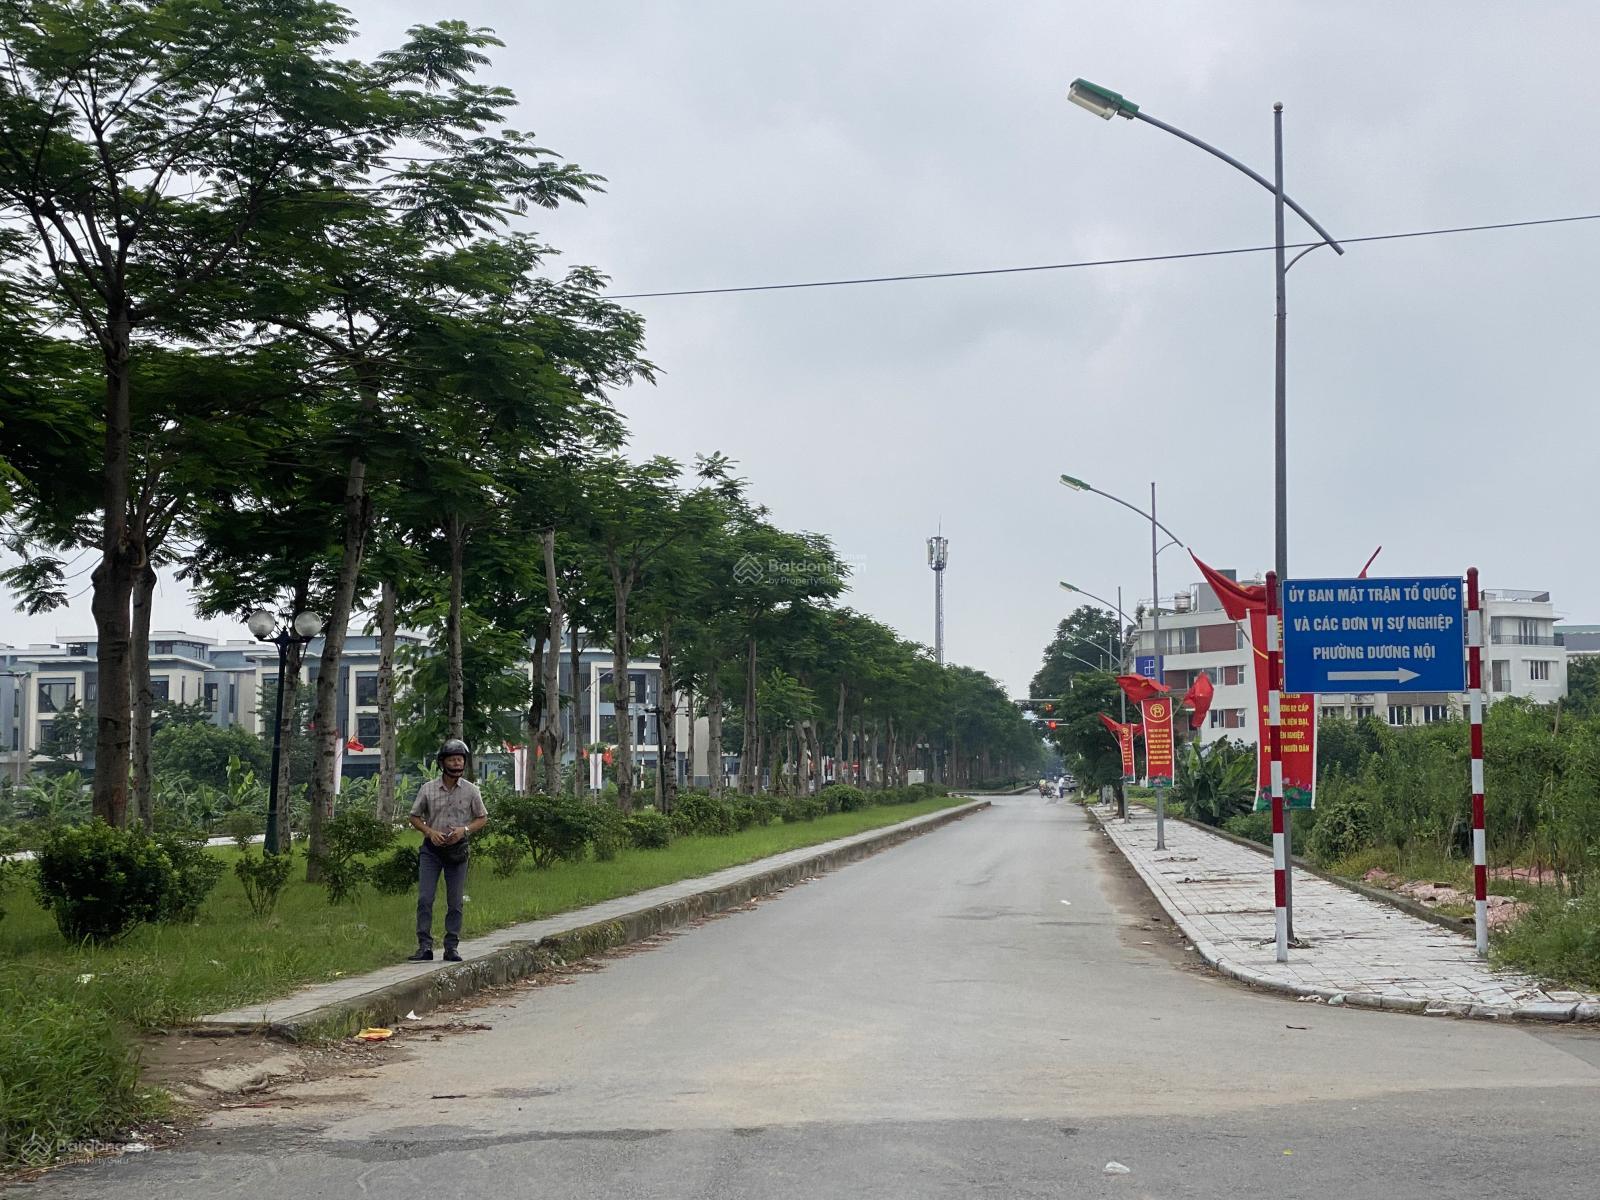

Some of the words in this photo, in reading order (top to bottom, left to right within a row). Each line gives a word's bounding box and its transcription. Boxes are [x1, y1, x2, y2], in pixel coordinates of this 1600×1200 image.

[1288, 585, 1304, 602] ỦY
[1308, 588, 1334, 602] BAN
[1337, 586, 1365, 604] MẶT
[1368, 585, 1400, 604] TRẬN
[1404, 582, 1420, 601] TỔ
[1423, 583, 1457, 602] QUỐC
[1294, 615, 1310, 631] VÀ
[1313, 615, 1339, 631] CÁC
[1341, 615, 1368, 631] ĐƠN
[1371, 617, 1384, 632] VỊ
[1387, 615, 1406, 632] SỰ
[1407, 613, 1453, 632] NGHIỆP
[1313, 643, 1364, 660] PHƯỜNG
[1367, 644, 1410, 659] DƯƠNG
[1413, 643, 1436, 661] NỘI
